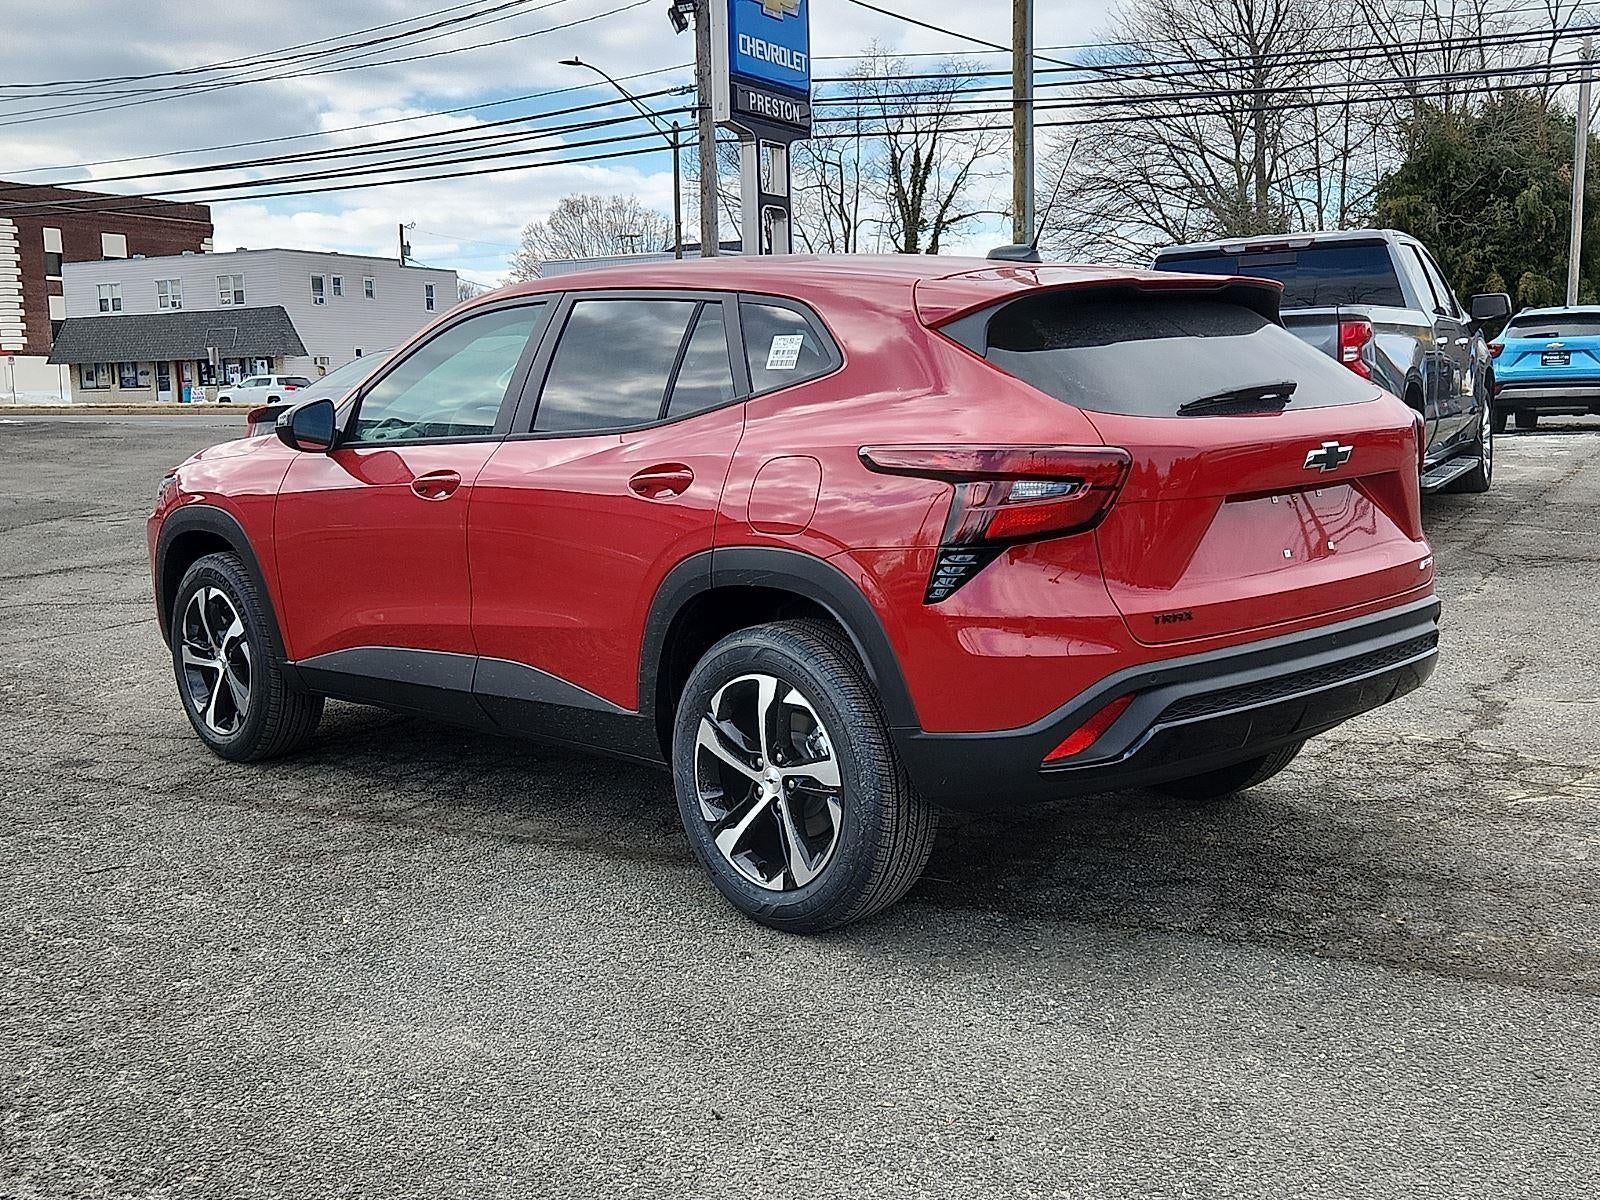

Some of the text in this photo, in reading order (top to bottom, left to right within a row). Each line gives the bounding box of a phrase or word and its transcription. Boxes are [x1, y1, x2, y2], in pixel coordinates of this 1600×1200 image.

[738, 33, 807, 73] CHEVROLET
[749, 91, 801, 123] PRESTON
[1152, 610, 1194, 625] TRAX
